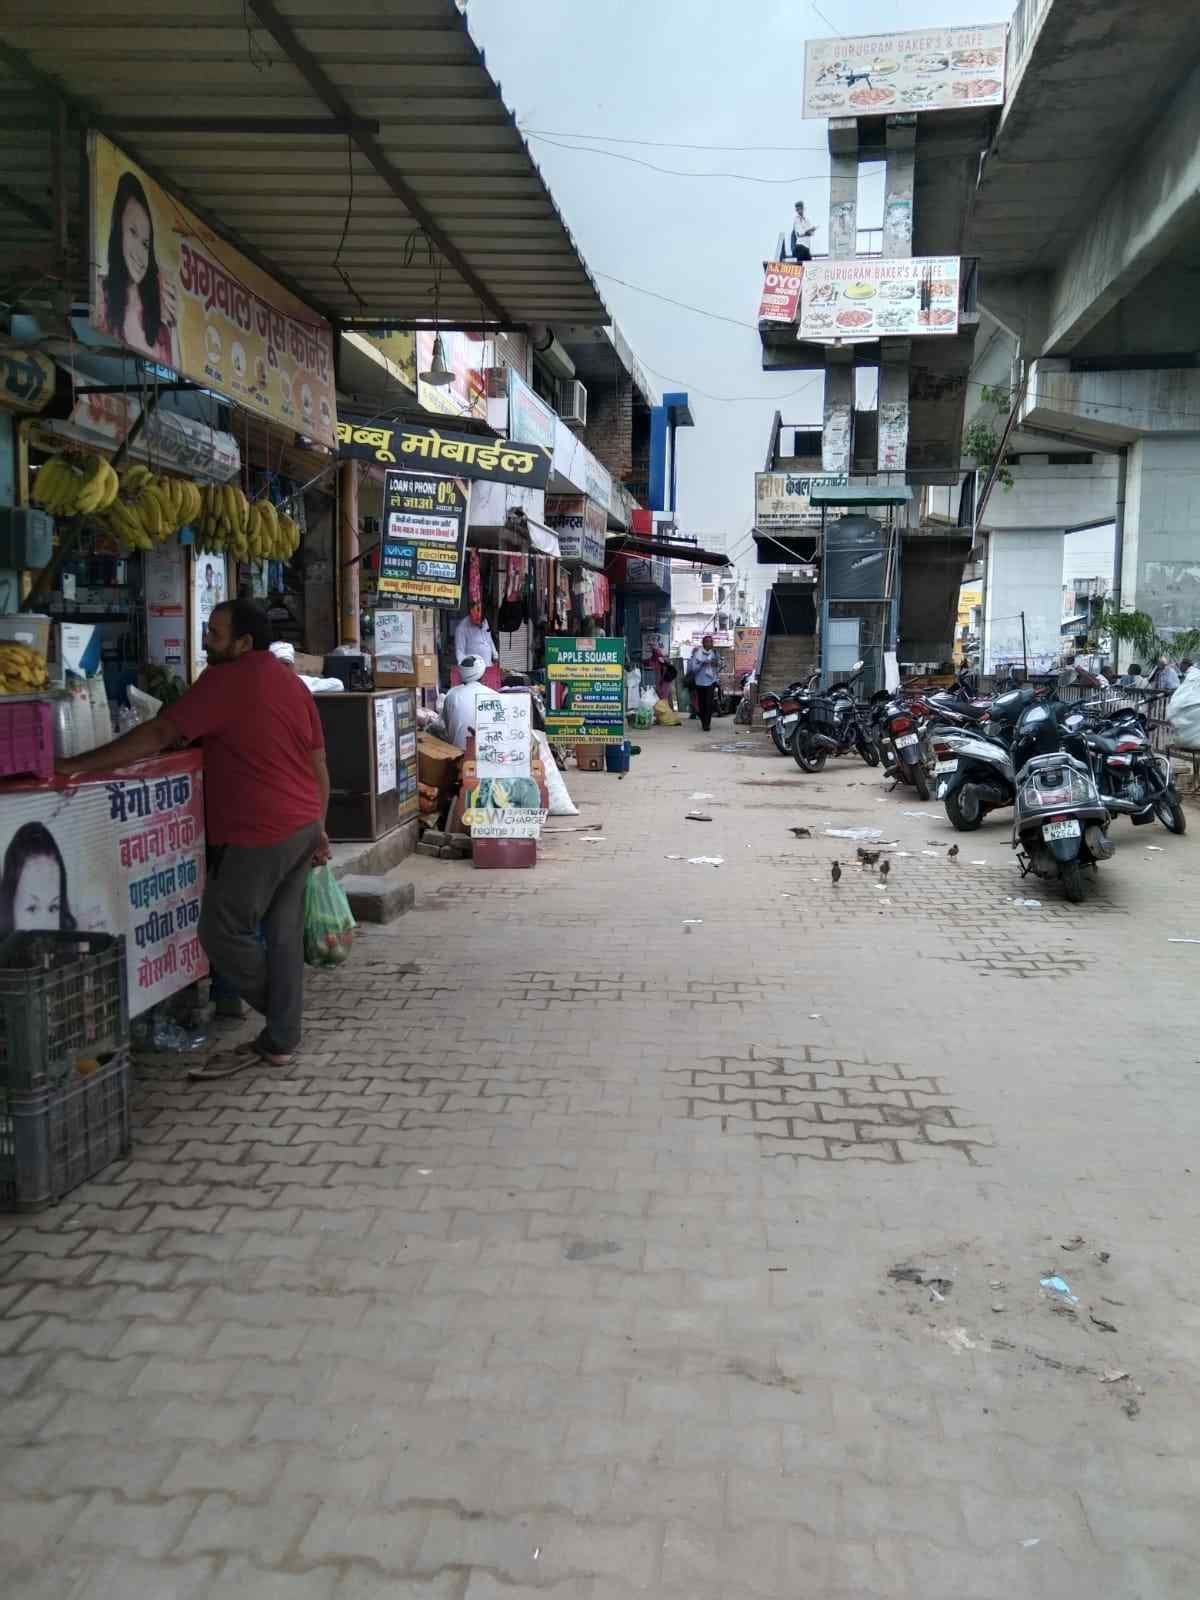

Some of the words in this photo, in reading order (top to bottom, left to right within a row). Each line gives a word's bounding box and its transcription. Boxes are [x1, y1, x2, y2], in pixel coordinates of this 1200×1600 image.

[833, 42, 894, 58] GURUGRAM
[957, 33, 984, 48] CAFE
[824, 264, 872, 281] GURUGRAM
[921, 264, 943, 278] CAFE
[765, 273, 800, 290] OYO
[179, 243, 252, 332] अग्रवाल
[255, 306, 286, 369] जूस
[401, 427, 540, 473] मोबाईल
[389, 479, 408, 491] LOAN
[414, 481, 437, 495] PHONE
[438, 481, 456, 504] 0%
[390, 492, 401, 507] ले
[403, 495, 434, 510] जाओ
[387, 545, 413, 556] vivo
[419, 551, 457, 561] realme
[384, 557, 413, 568] SAMSUNG
[557, 651, 583, 663] APPLE
[585, 651, 618, 663] SQUARE
[512, 706, 526, 719] 30
[510, 729, 525, 741] 50
[511, 751, 525, 762] 50
[105, 777, 152, 822] मैंगो
[155, 775, 190, 811] शेक
[504, 816, 545, 825] CHARGE
[473, 824, 508, 836] realme
[119, 828, 165, 868] बनाना
[168, 816, 194, 851] शेक
[128, 866, 176, 909] पाइनेपल
[176, 856, 197, 888] शेक
[134, 907, 174, 949] पपीता
[176, 898, 200, 931] शेक
